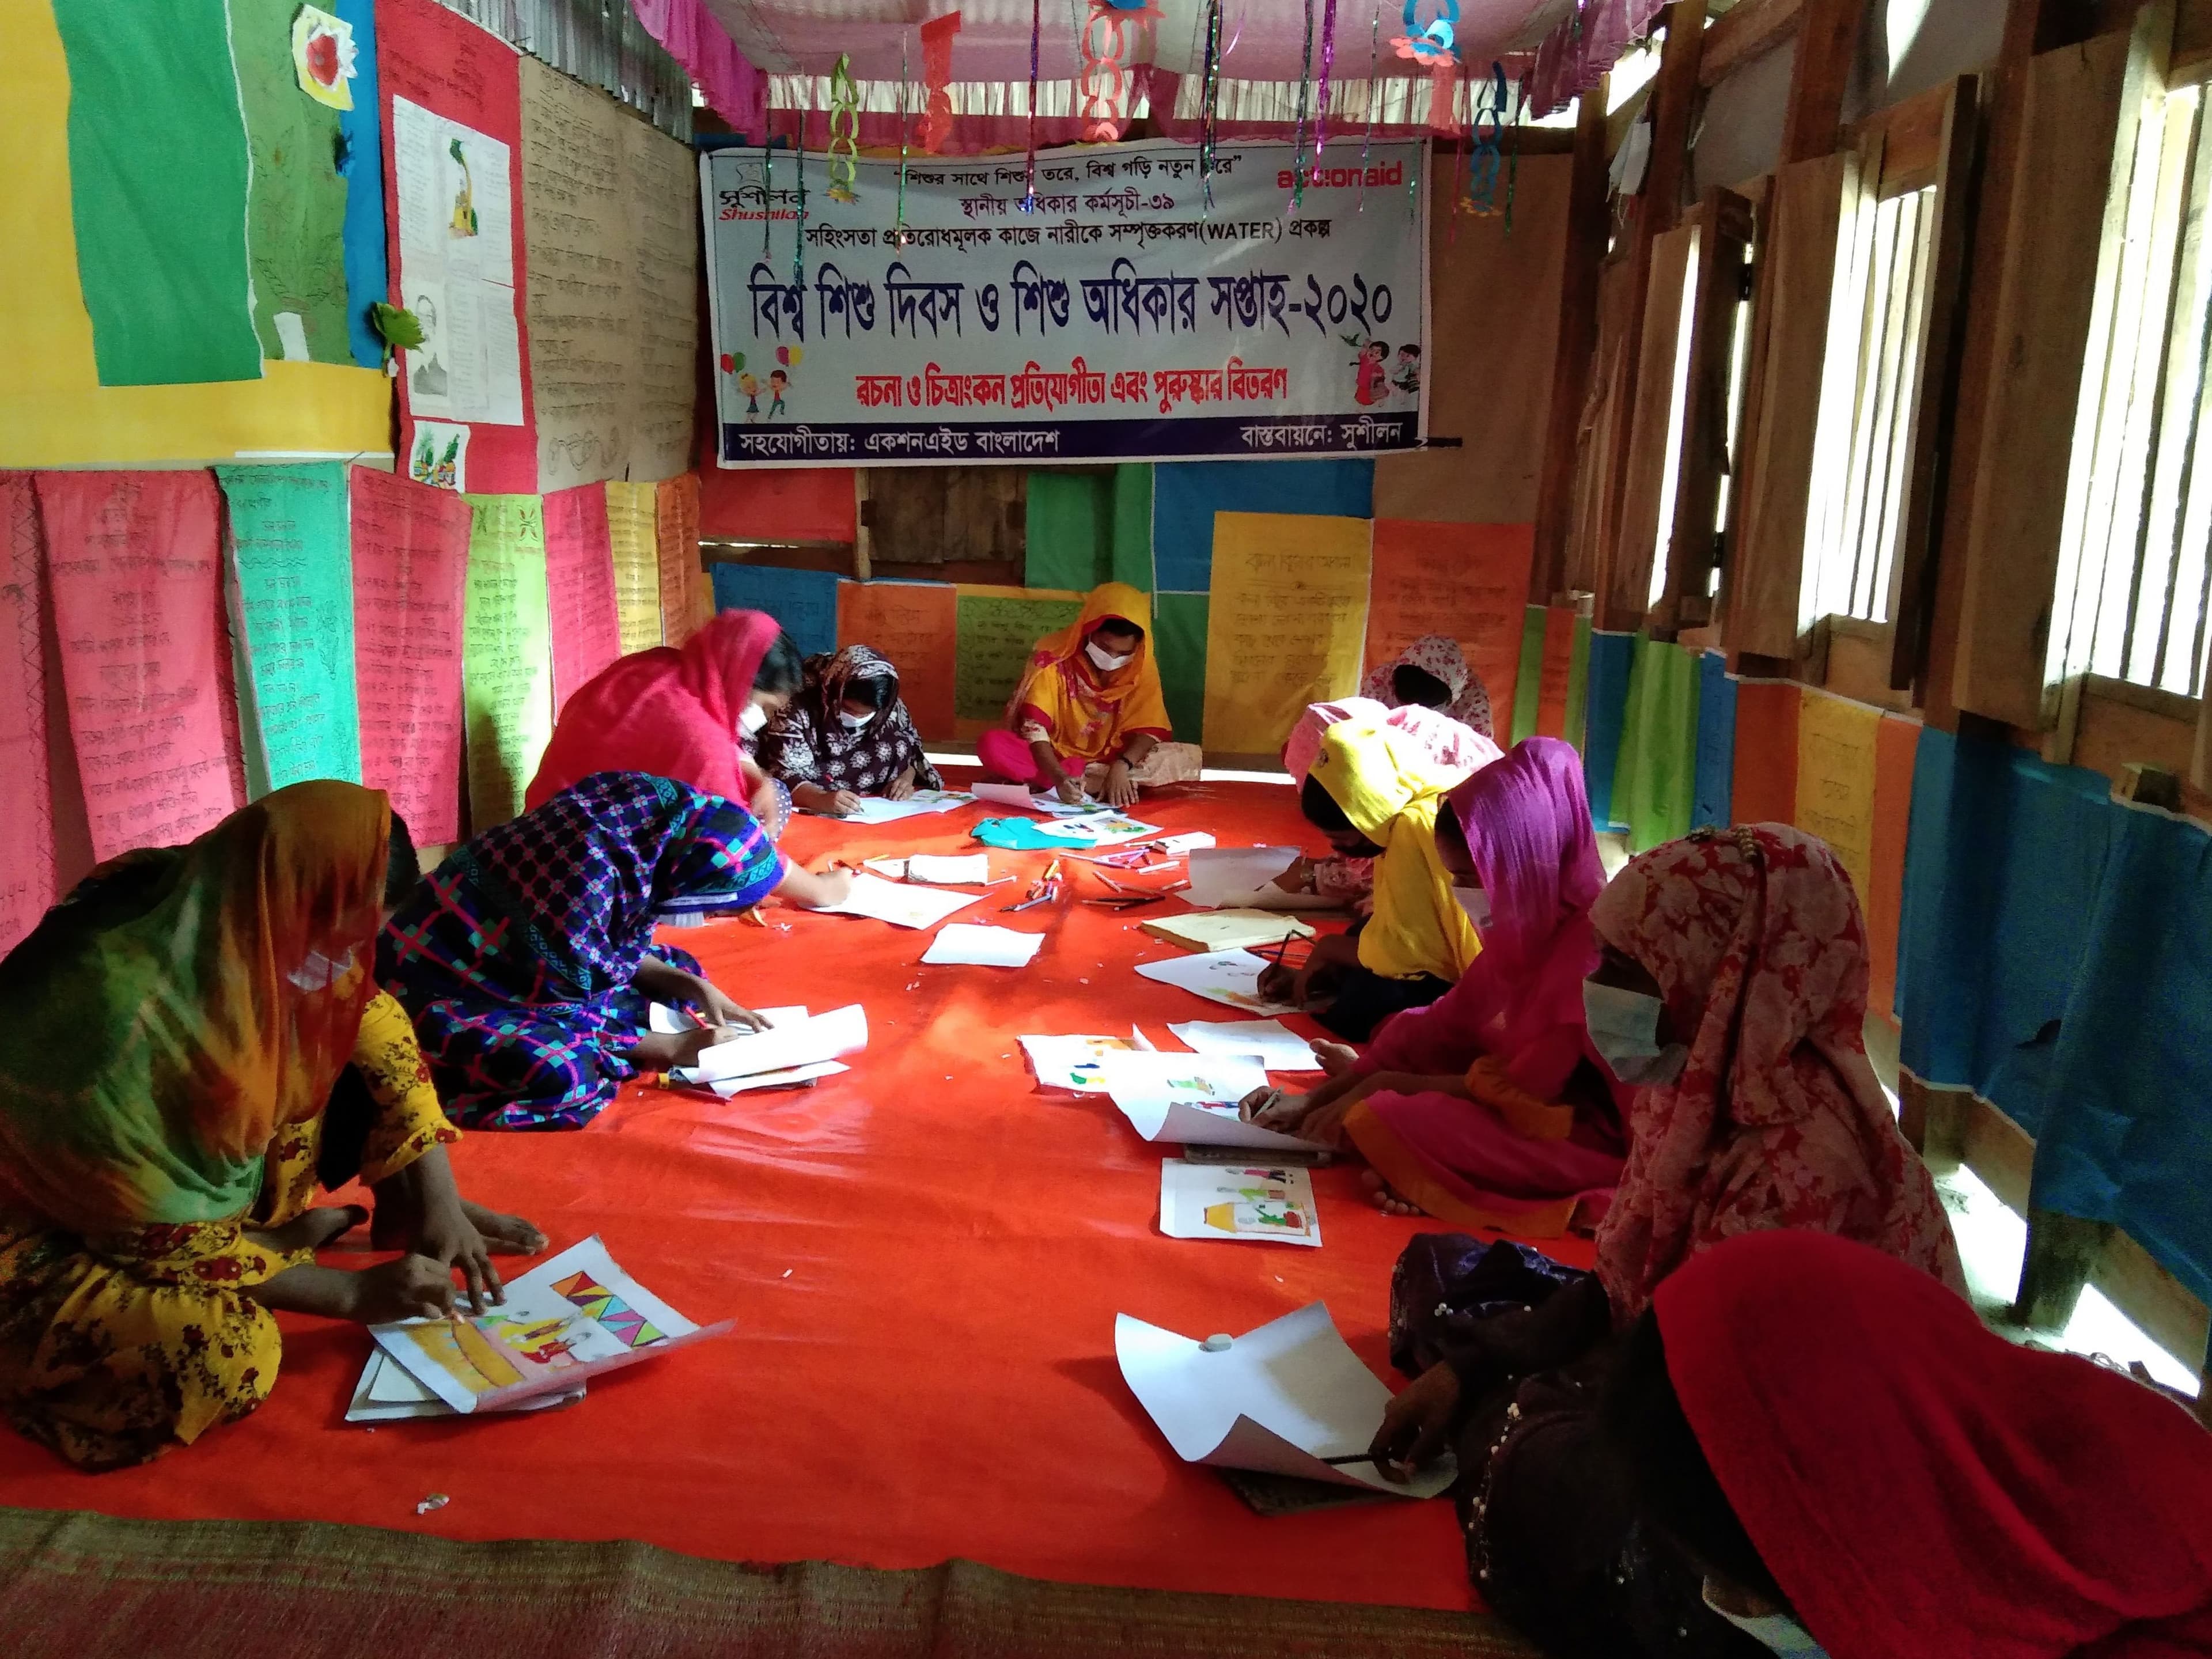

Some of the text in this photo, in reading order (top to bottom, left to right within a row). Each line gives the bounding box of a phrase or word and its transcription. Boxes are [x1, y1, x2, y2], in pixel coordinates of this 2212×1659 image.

[951, 172, 988, 185] সাথে
[994, 168, 1034, 185] শিশু
[1086, 160, 1116, 179] বিশ্ব
[1122, 156, 1153, 179] গড়ি
[1157, 159, 1195, 180] নতুন
[1200, 155, 1242, 175] রে”
[959, 193, 1008, 220] স্থানীয়
[805, 223, 878, 249] সহিংসতা
[995, 225, 1041, 245] কাজে
[1046, 219, 1104, 245] নারীকে
[1289, 219, 1332, 238] প্রকল্প
[747, 257, 1392, 343] বিশ্ব শিশু দিবস ও শিশু অধিকার সপ্তাহ-২০২০
[855, 376, 902, 407] রচনা
[906, 375, 922, 407] ও
[924, 362, 1006, 407] চিত্রাংকন
[1009, 355, 1107, 413] প্রতিযোগীতা
[1110, 371, 1148, 404] এবং
[1227, 355, 1288, 401] বিতরণ
[864, 425, 970, 454] একশনএইড
[974, 429, 1060, 454] বাংলাদেশ
